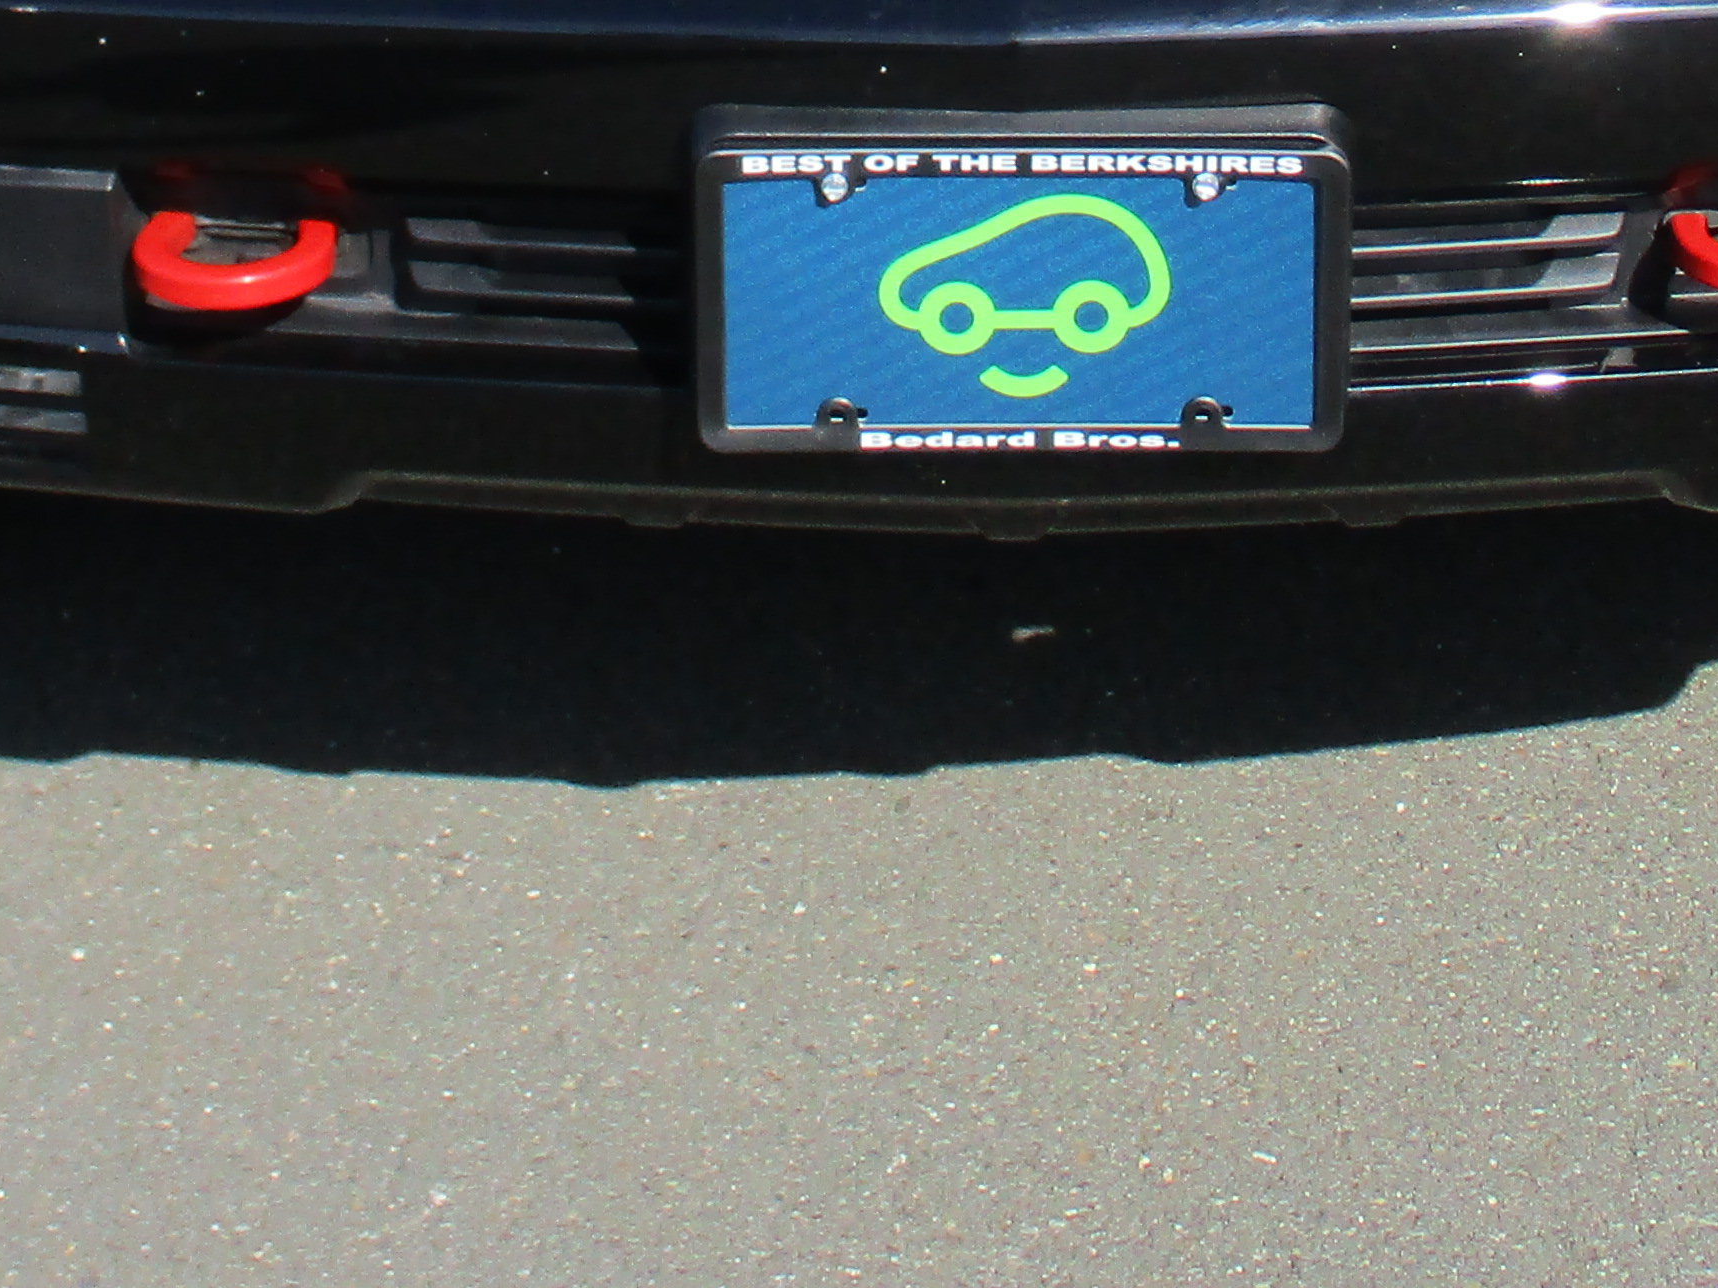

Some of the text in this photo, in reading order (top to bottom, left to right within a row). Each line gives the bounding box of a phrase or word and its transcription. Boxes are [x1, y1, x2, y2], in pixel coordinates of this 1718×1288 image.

[741, 154, 1304, 175] BEST OF THE BERKSHIRES
[860, 430, 1181, 450] Bedard Bros.
